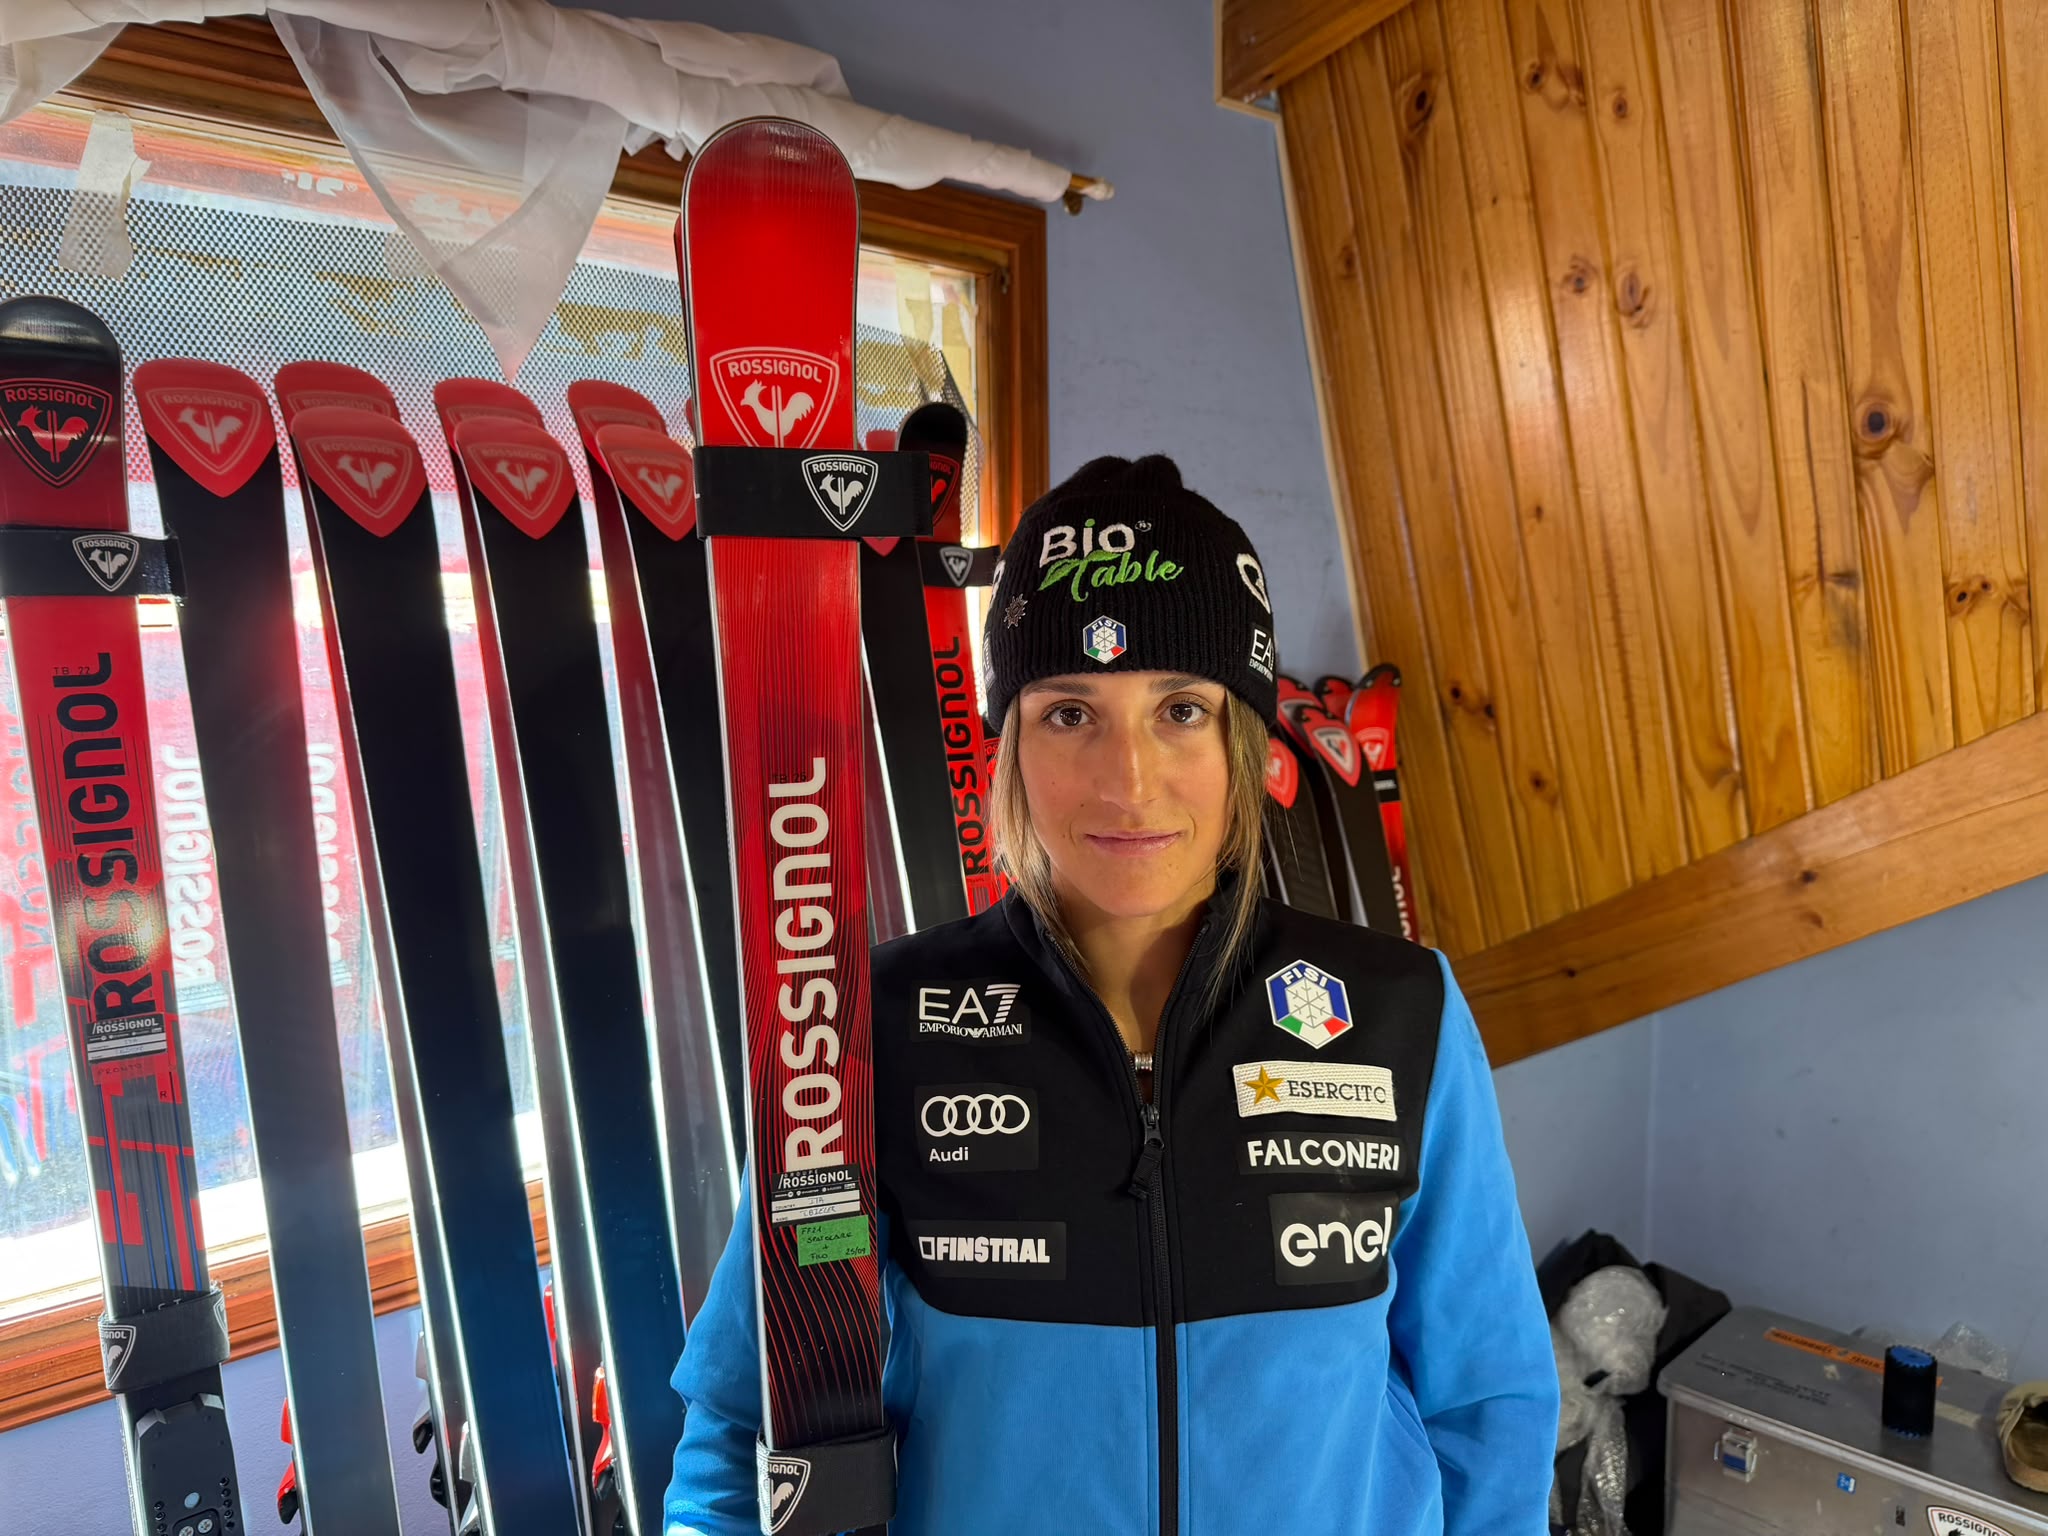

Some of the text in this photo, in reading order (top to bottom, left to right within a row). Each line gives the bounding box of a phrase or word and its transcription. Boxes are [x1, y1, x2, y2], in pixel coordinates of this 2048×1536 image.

[728, 359, 822, 383] ROSSIGNOL
[5, 388, 97, 410] ROSSIGNOL
[812, 461, 869, 476] ROSSIGNOL
[82, 539, 132, 551] ROSSIGNOL
[1091, 619, 1118, 631] FISI
[934, 636, 989, 876] ROSSIGNOL
[52, 652, 156, 1021] ROSSIGNOL
[768, 756, 844, 1172] ROSSIGNOL
[1281, 967, 1328, 988] FISI
[919, 983, 1021, 1025] EA7
[919, 1022, 1022, 1039] EMPORIO ARMANI
[1287, 1080, 1386, 1103] ESERCITO
[929, 1147, 969, 1162] Audi
[1247, 1139, 1400, 1171] FALCONERI
[1280, 1207, 1392, 1267] enel
[937, 1236, 1050, 1263] FINSTRAL
